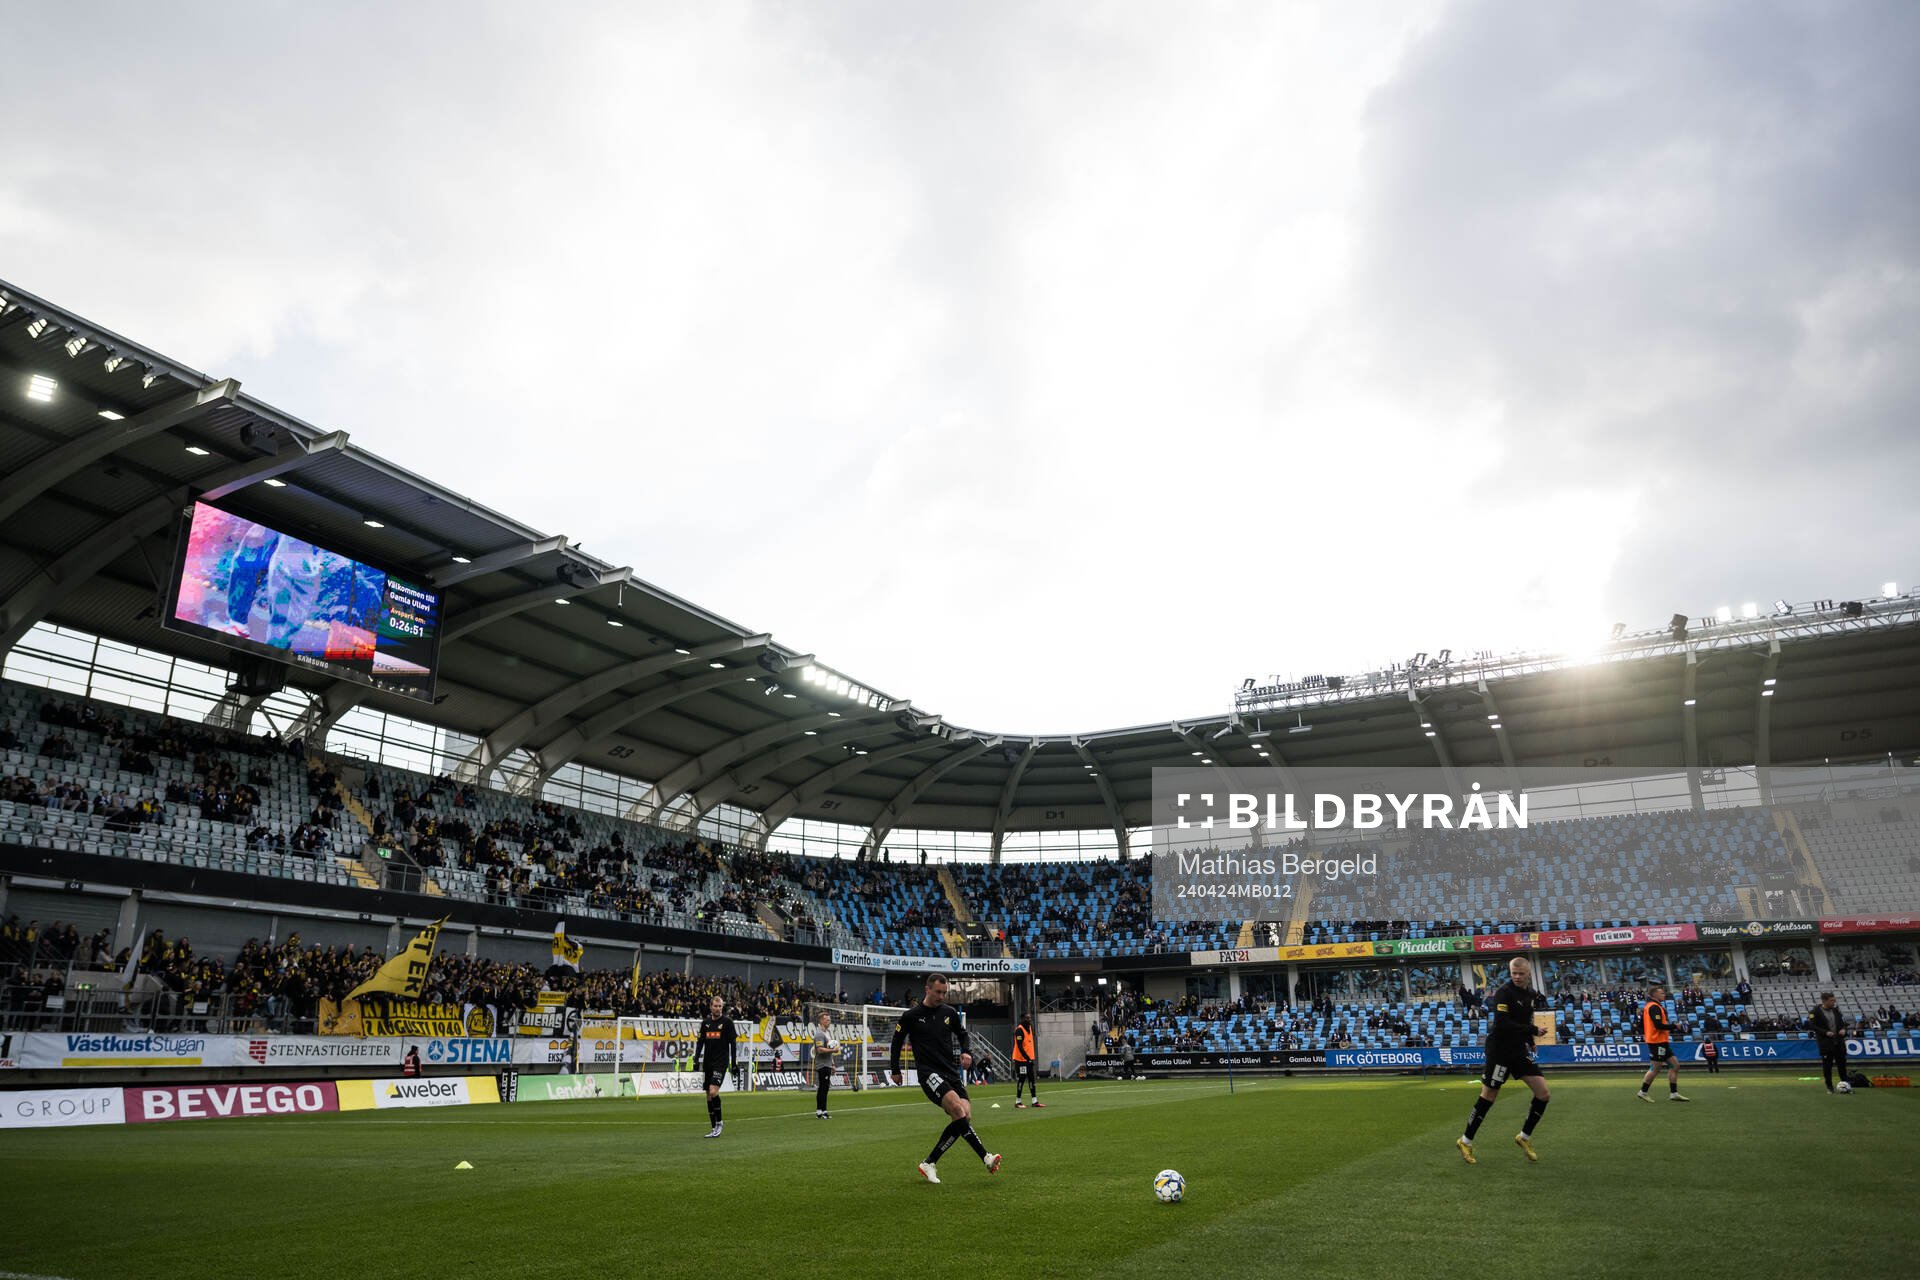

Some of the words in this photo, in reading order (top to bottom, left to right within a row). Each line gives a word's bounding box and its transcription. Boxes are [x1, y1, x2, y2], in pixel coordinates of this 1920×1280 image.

[390, 591, 411, 606] Gamla
[411, 599, 431, 612] Ullevi
[390, 607, 414, 620] Avspark
[389, 617, 424, 637] 0:26:51
[297, 654, 329, 669] SAMSUNG
[607, 745, 634, 759] B3
[1045, 811, 1065, 820] D1
[1701, 925, 1737, 937] Härryda
[1773, 922, 1813, 933] Karlsson
[1398, 939, 1448, 953] Picadeli
[841, 950, 880, 967] merinfo.se
[962, 960, 1027, 972] merinfo.se
[432, 1021, 462, 1036] 1940
[269, 1044, 391, 1057] STENFASTIGHETER
[446, 1039, 511, 1063] STENA
[1572, 1043, 1641, 1057] FAMECO
[1846, 1038, 1920, 1056] OBILL
[1086, 1059, 1106, 1067] Gamla
[1106, 1059, 1125, 1067] Ullevi
[1151, 1058, 1171, 1066] Gamla
[1219, 1057, 1238, 1065] Gamla
[1239, 1056, 1261, 1064] Ullevi
[1335, 1053, 1353, 1065] IFK
[1356, 1051, 1422, 1065] GÖTEBORG
[752, 1071, 807, 1086] OPTIMERA
[403, 1079, 458, 1099] weber
[509, 1071, 518, 1103] SELECT
[16, 1097, 111, 1118] GROUP
[142, 1085, 324, 1120] BEVEGO
